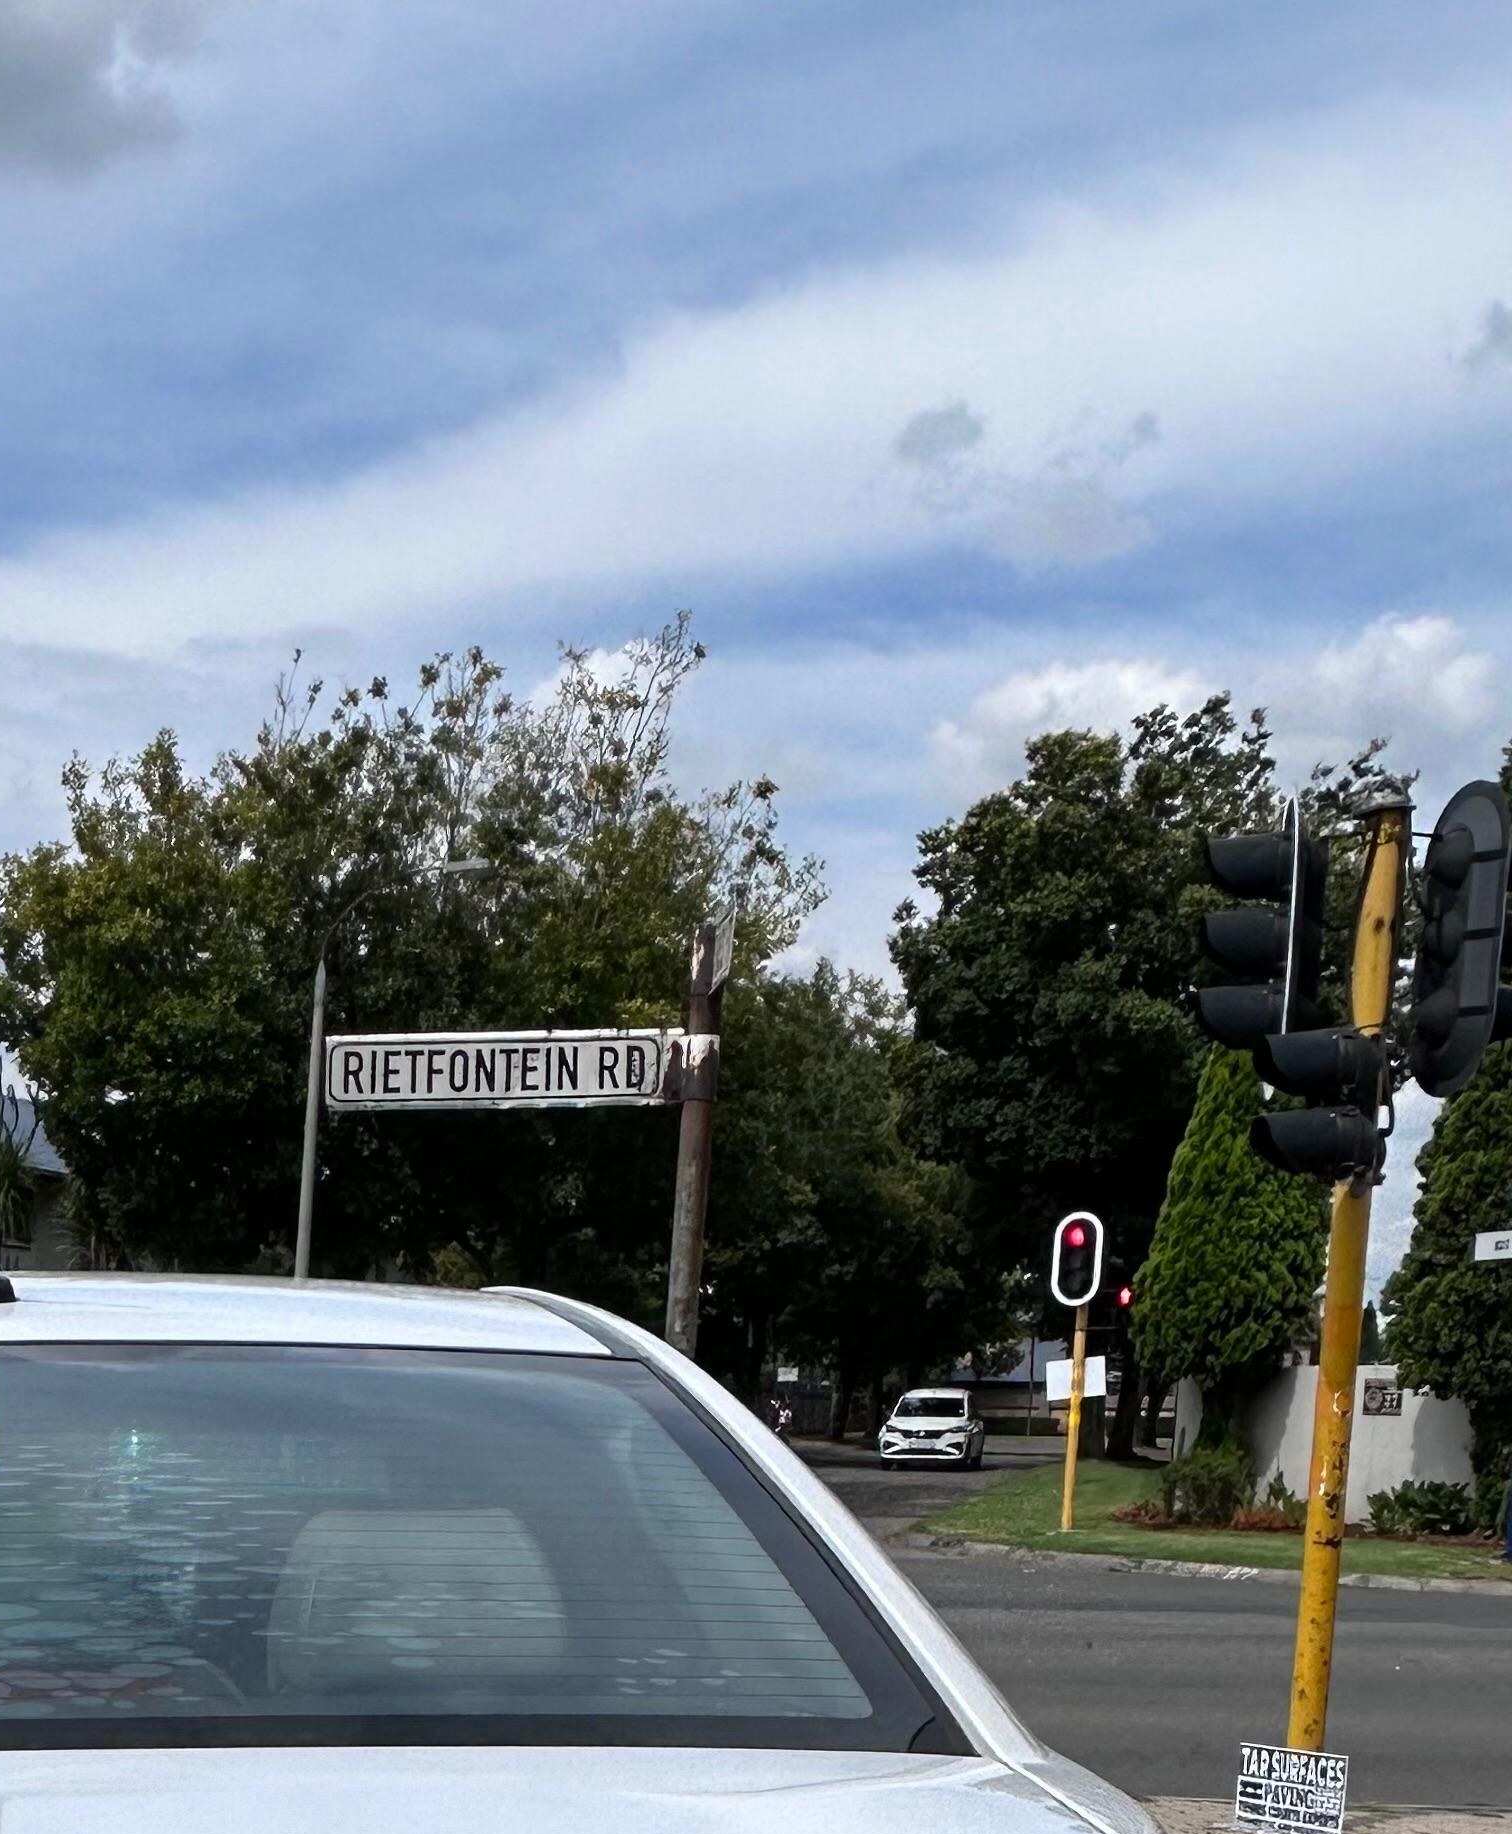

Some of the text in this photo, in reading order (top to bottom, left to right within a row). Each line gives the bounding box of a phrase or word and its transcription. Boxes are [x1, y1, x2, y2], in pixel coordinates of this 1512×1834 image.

[343, 1045, 646, 1095] RIETFONTEIN RD
[1241, 1747, 1345, 1789] TAR SURFACES
[1264, 1782, 1316, 1810] PAVING
